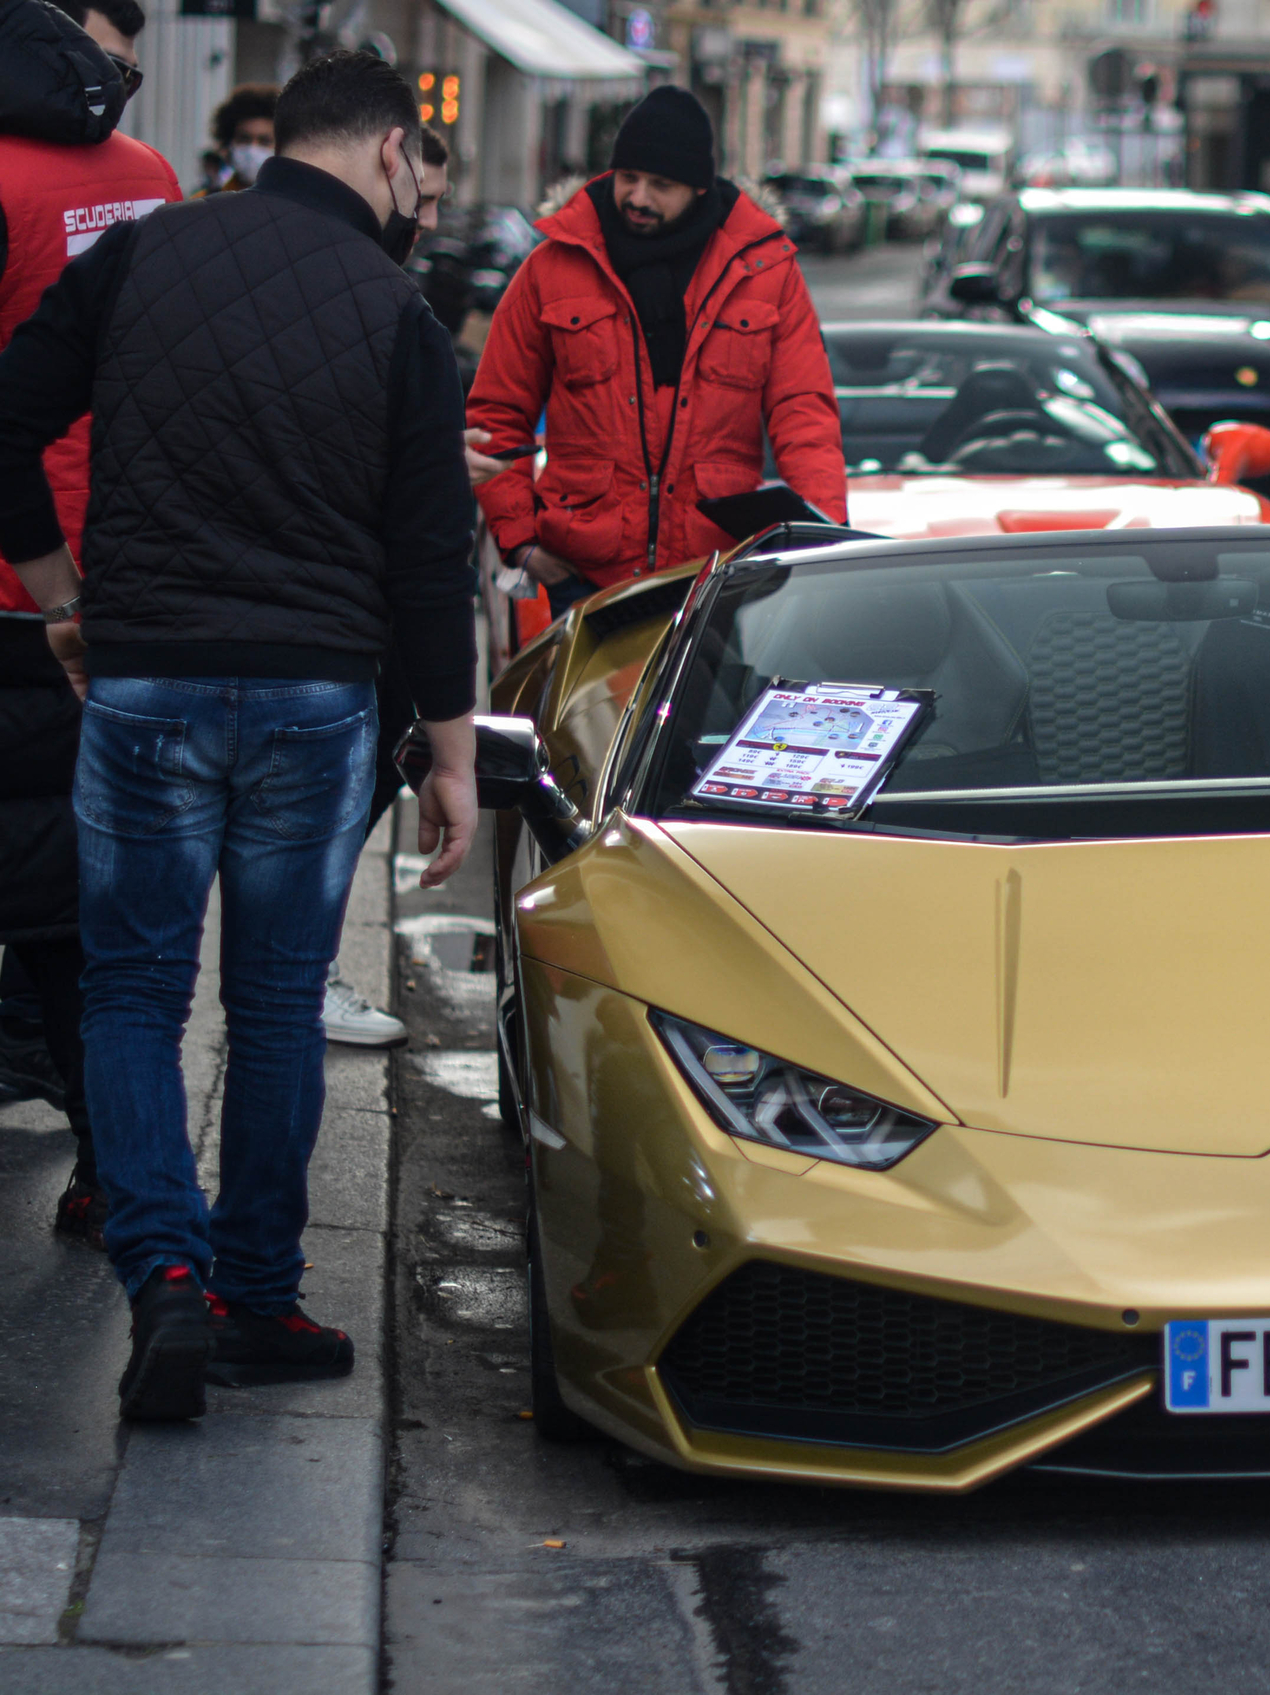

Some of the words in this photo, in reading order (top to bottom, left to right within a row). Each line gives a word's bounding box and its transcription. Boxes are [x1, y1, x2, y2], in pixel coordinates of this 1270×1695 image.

[63, 200, 134, 233] SCUDERIA
[773, 693, 800, 701] ONLY
[821, 698, 866, 707] BOOKING
[1183, 1371, 1196, 1390] F
